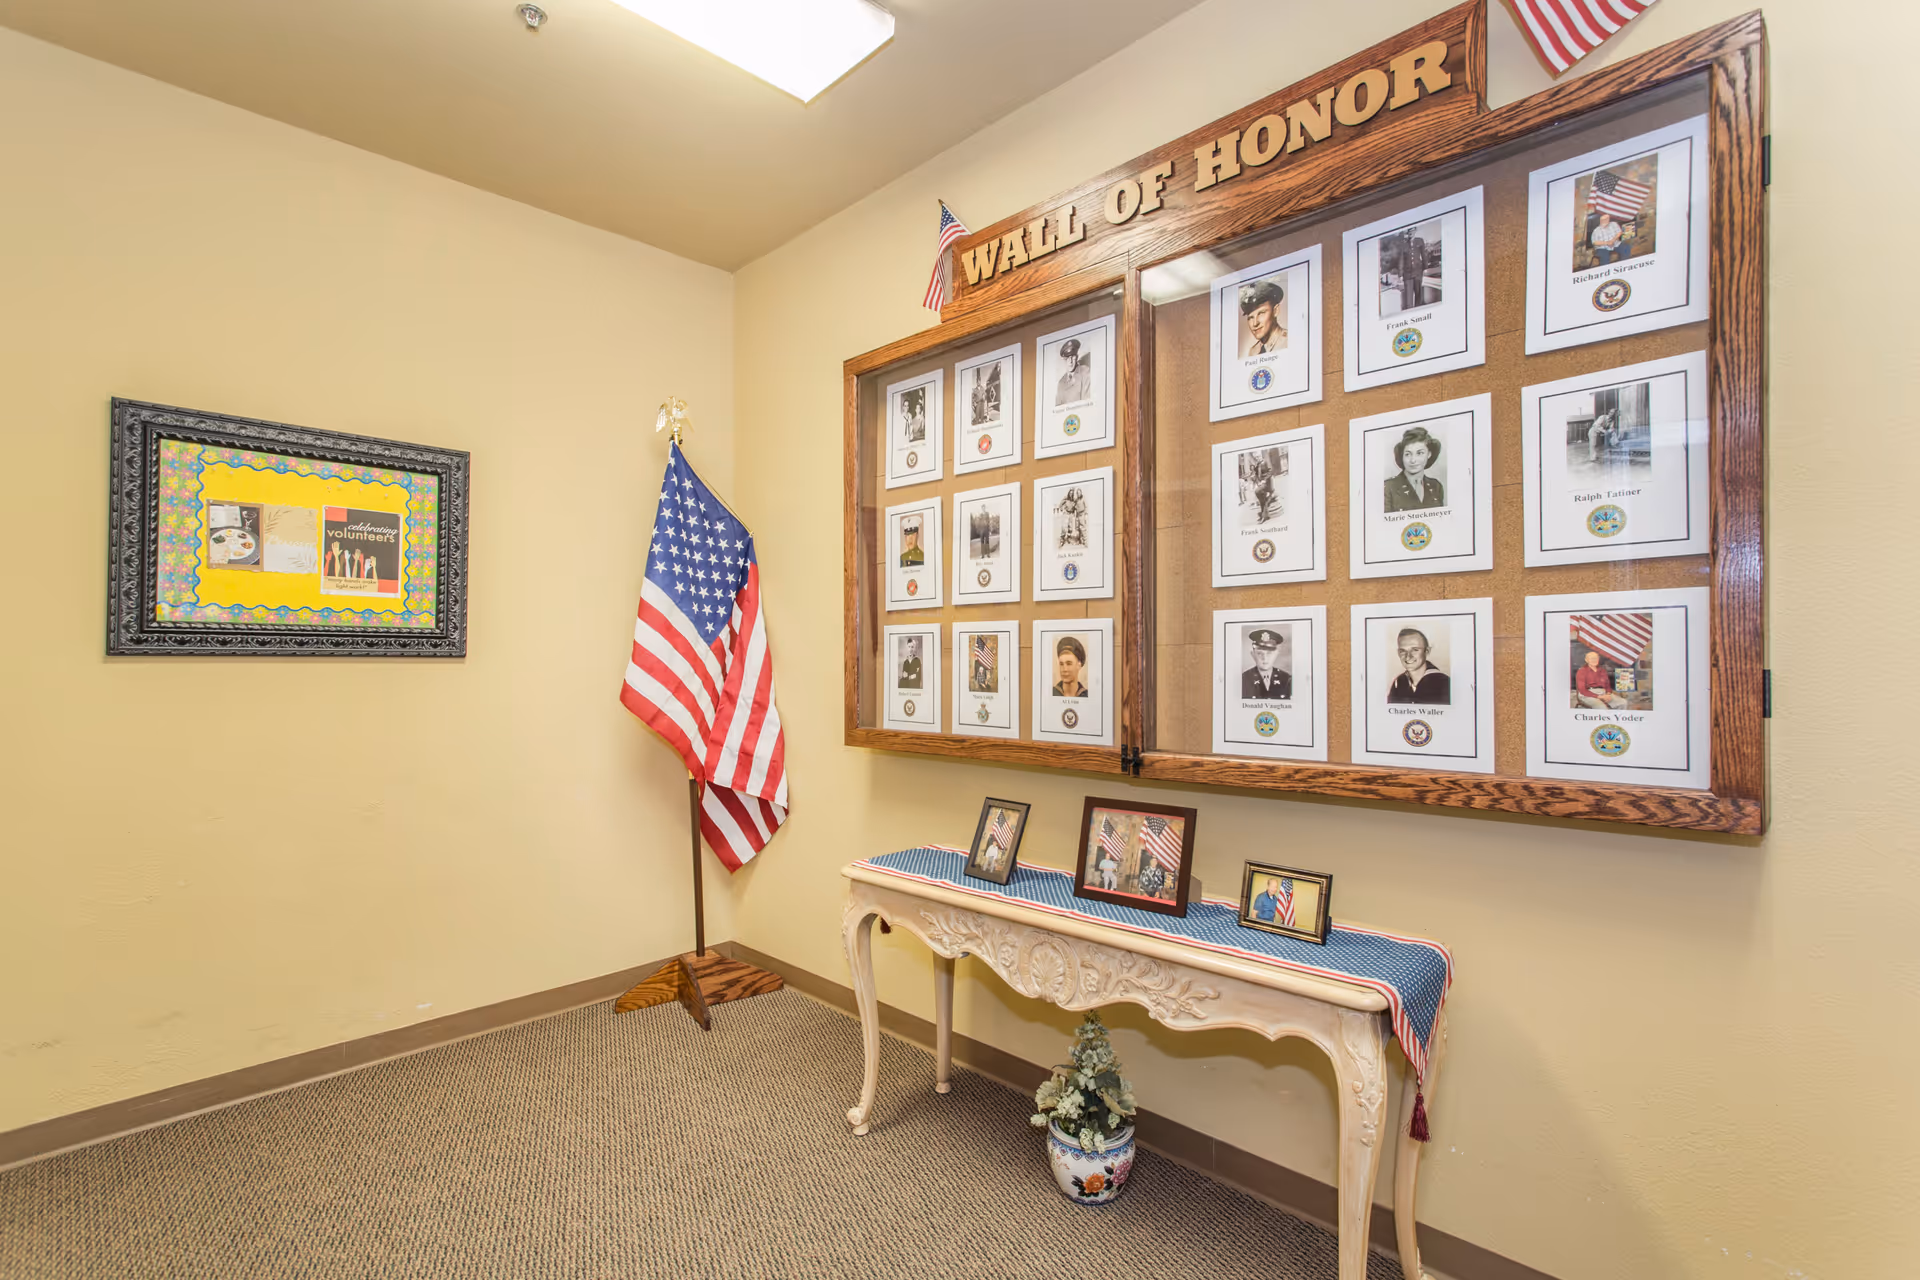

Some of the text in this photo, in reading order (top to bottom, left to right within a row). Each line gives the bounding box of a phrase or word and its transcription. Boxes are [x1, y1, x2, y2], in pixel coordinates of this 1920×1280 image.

[961, 40, 1452, 286] WALL OF HONOR
[1572, 259, 1655, 285] Richard Siracuse
[1386, 313, 1432, 331] Frank Small
[1574, 493, 1602, 502] Ralph
[327, 527, 395, 543] volunteers
[347, 522, 399, 536] celebrating
[1241, 529, 1259, 537] Frank
[1388, 707, 1445, 716] Charles Waller
[1574, 713, 1645, 722] Charles Yoder
